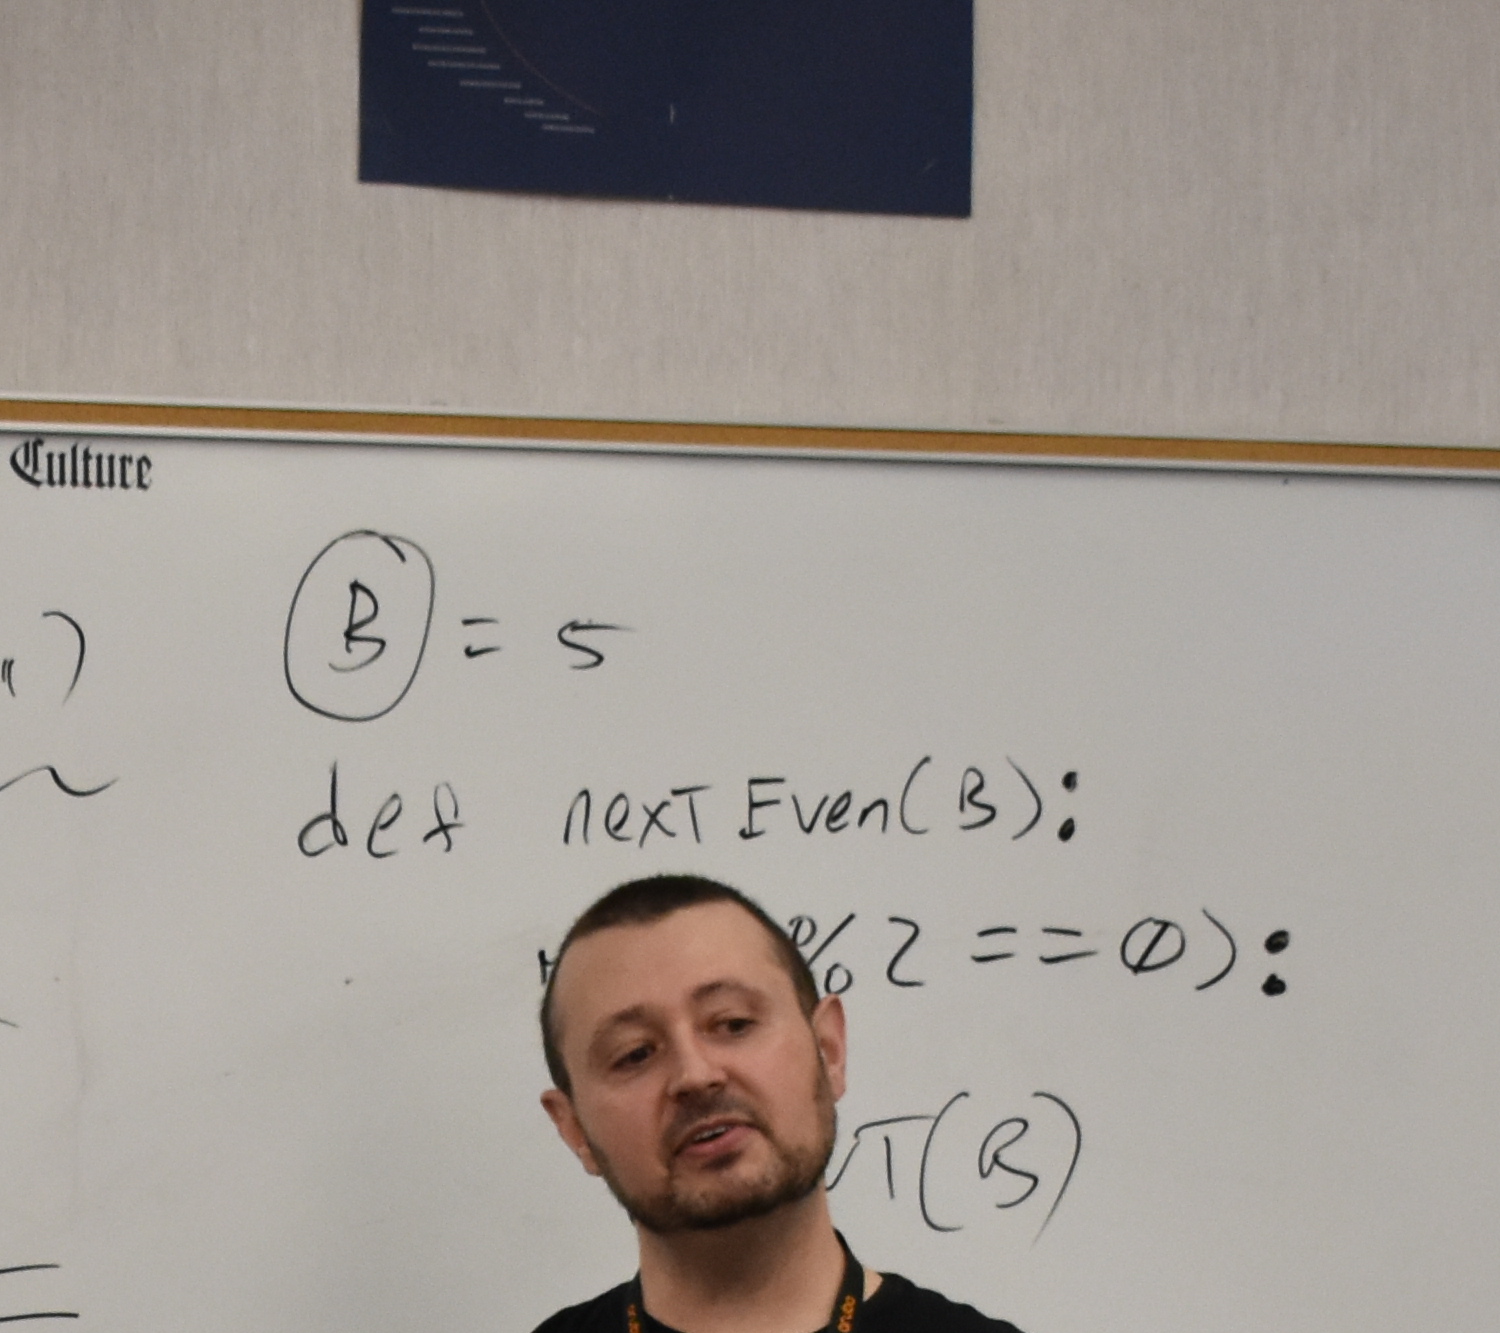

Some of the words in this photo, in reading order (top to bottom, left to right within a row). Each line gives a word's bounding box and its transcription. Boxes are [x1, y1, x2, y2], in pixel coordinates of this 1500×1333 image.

[8, 436, 155, 492] Culture
[328, 579, 387, 672] B
[460, 618, 501, 658] =
[556, 619, 634, 670] 5
[297, 761, 467, 860] def
